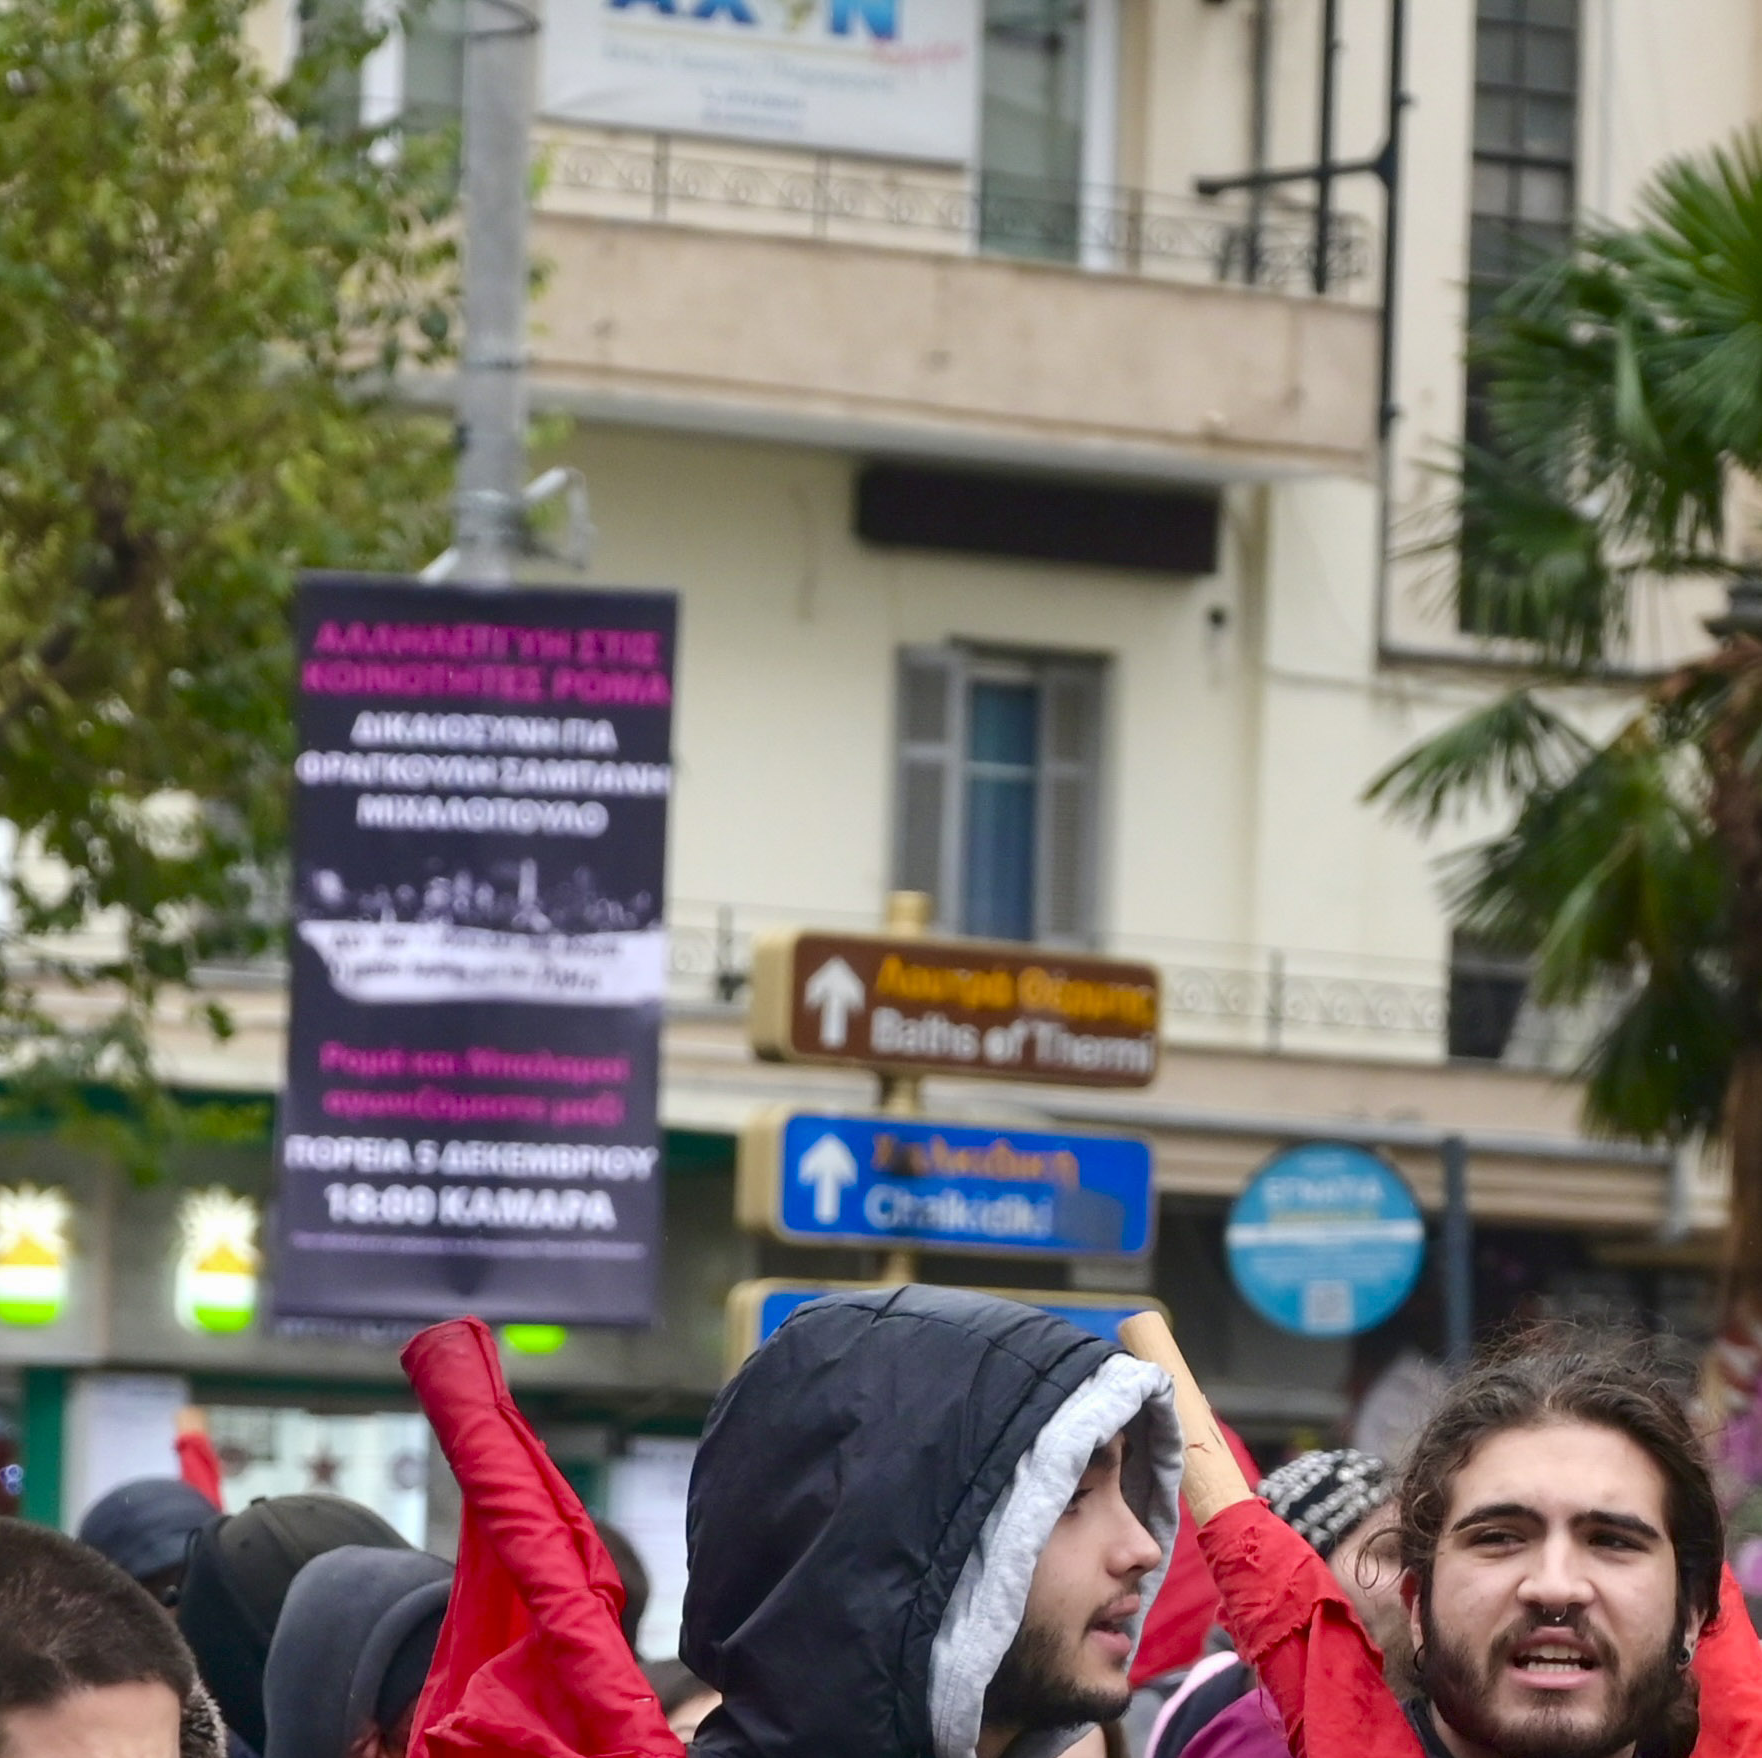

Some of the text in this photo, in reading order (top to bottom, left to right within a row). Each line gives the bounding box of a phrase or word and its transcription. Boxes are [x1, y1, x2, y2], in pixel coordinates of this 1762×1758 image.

[349, 710, 619, 754] ΔΙΚΑΙΟΣΥΝΗ ΓΙΑ
[870, 1007, 1154, 1074] Baths of Thermi
[284, 1133, 659, 1181] ΠΟΡΕΙΑ 5 ΔΕΚΕΜΒΡΙΟΥ
[324, 1183, 617, 1231] 18:00 ΚΑΜΑΡΑ
